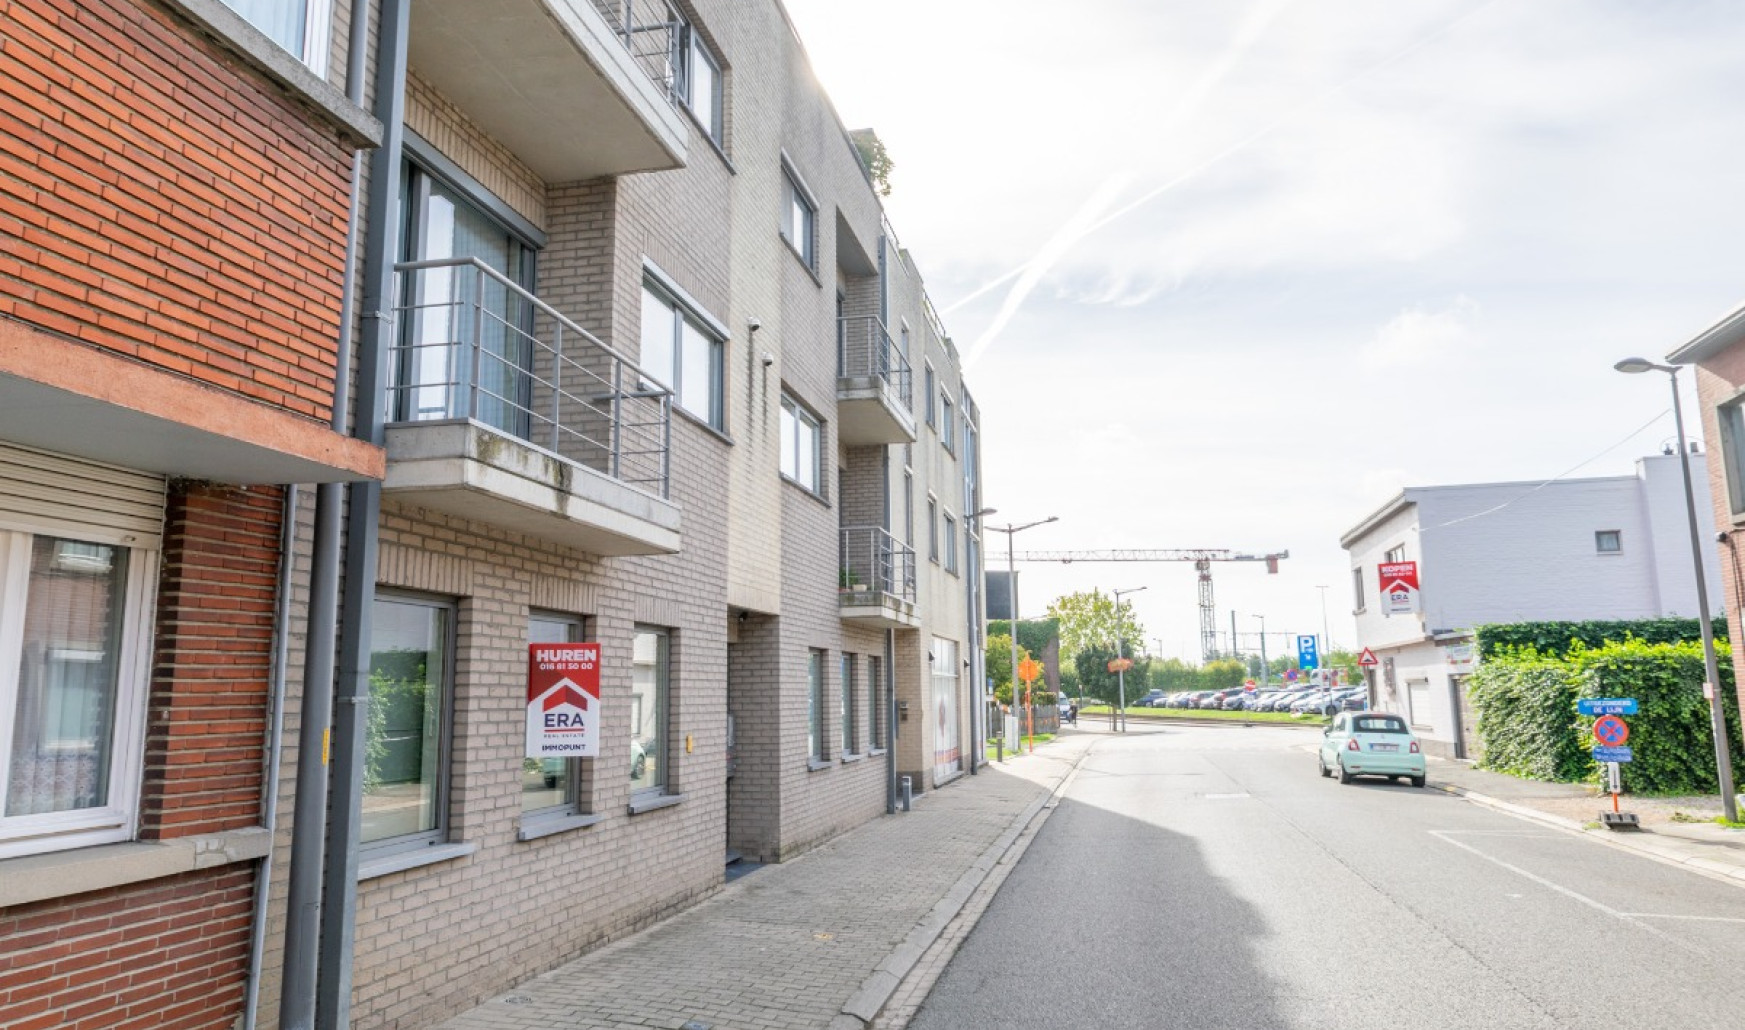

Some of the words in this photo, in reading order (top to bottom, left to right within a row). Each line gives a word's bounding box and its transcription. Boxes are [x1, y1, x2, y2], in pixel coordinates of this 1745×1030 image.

[1300, 636, 1313, 653] P
[537, 649, 597, 662] HUREN
[581, 662, 593, 670] 00
[544, 713, 584, 727] ERA
